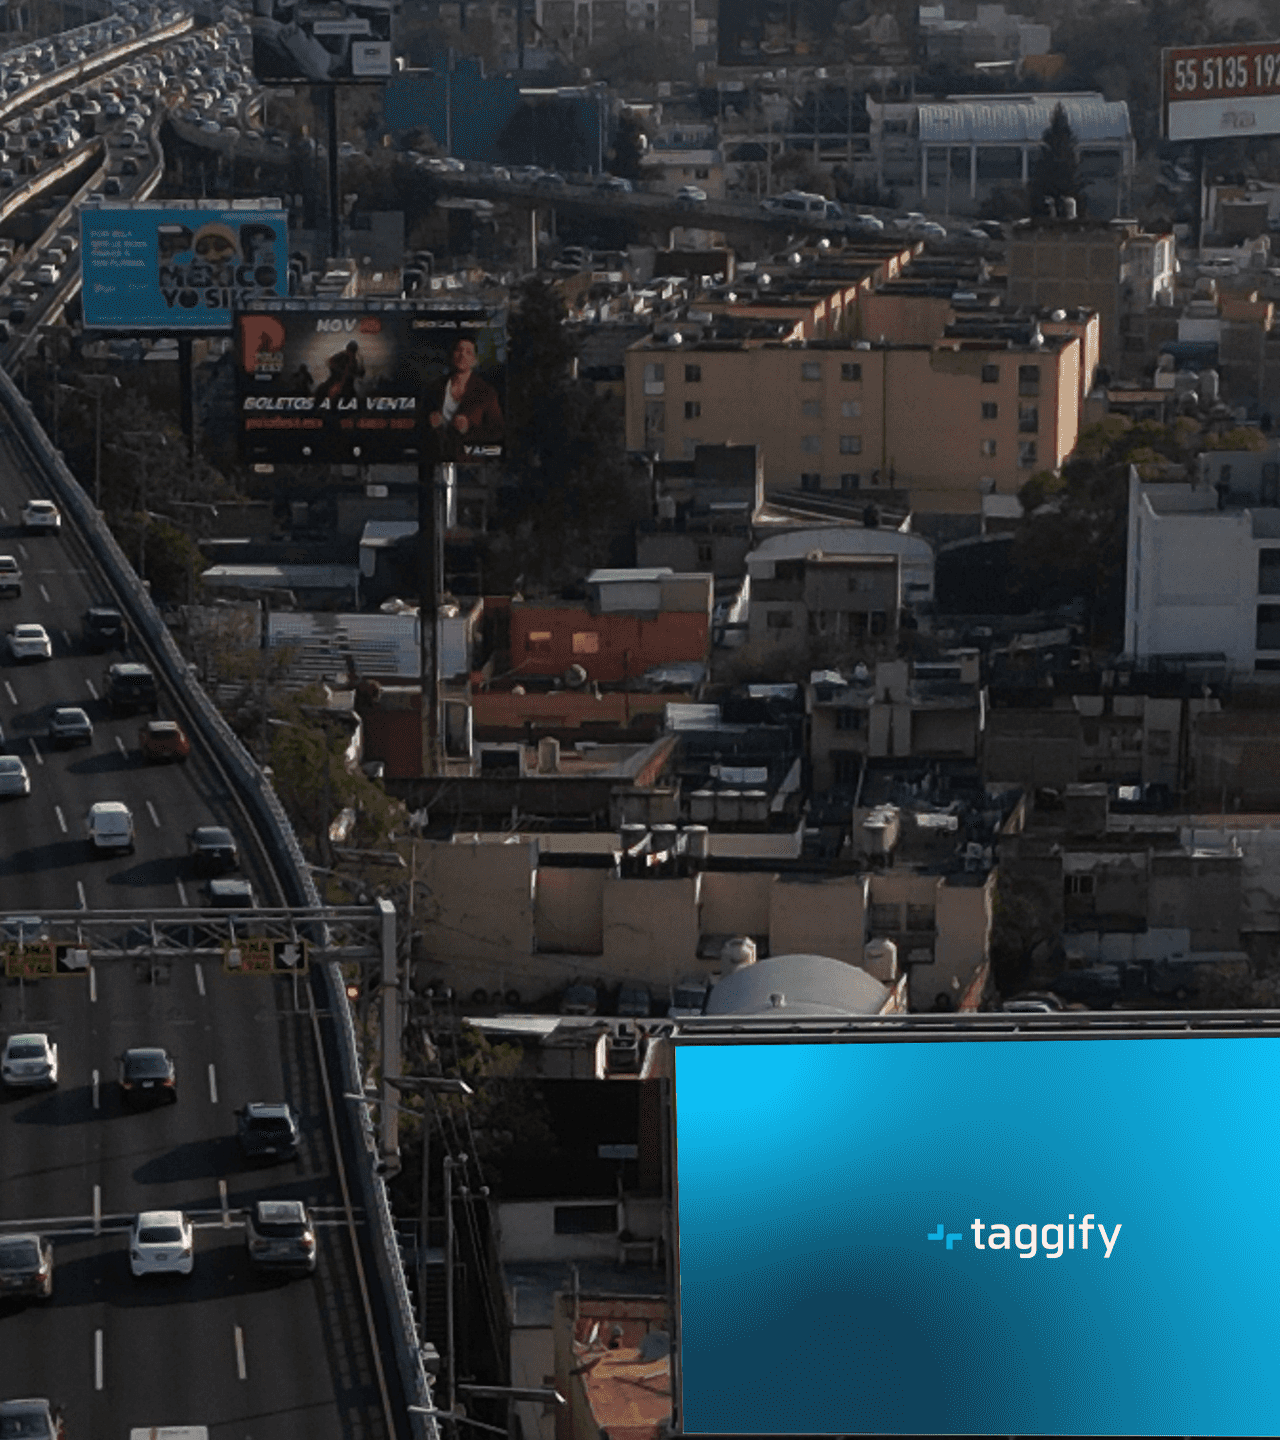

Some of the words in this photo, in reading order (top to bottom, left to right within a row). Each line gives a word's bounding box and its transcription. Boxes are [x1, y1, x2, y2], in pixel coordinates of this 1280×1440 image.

[1174, 58, 1198, 92] 55
[1202, 54, 1248, 90] 5135
[243, 397, 315, 410] BOLETOS
[337, 397, 358, 410] LA
[366, 397, 417, 410] VENTA
[971, 1213, 1123, 1259] taggify
